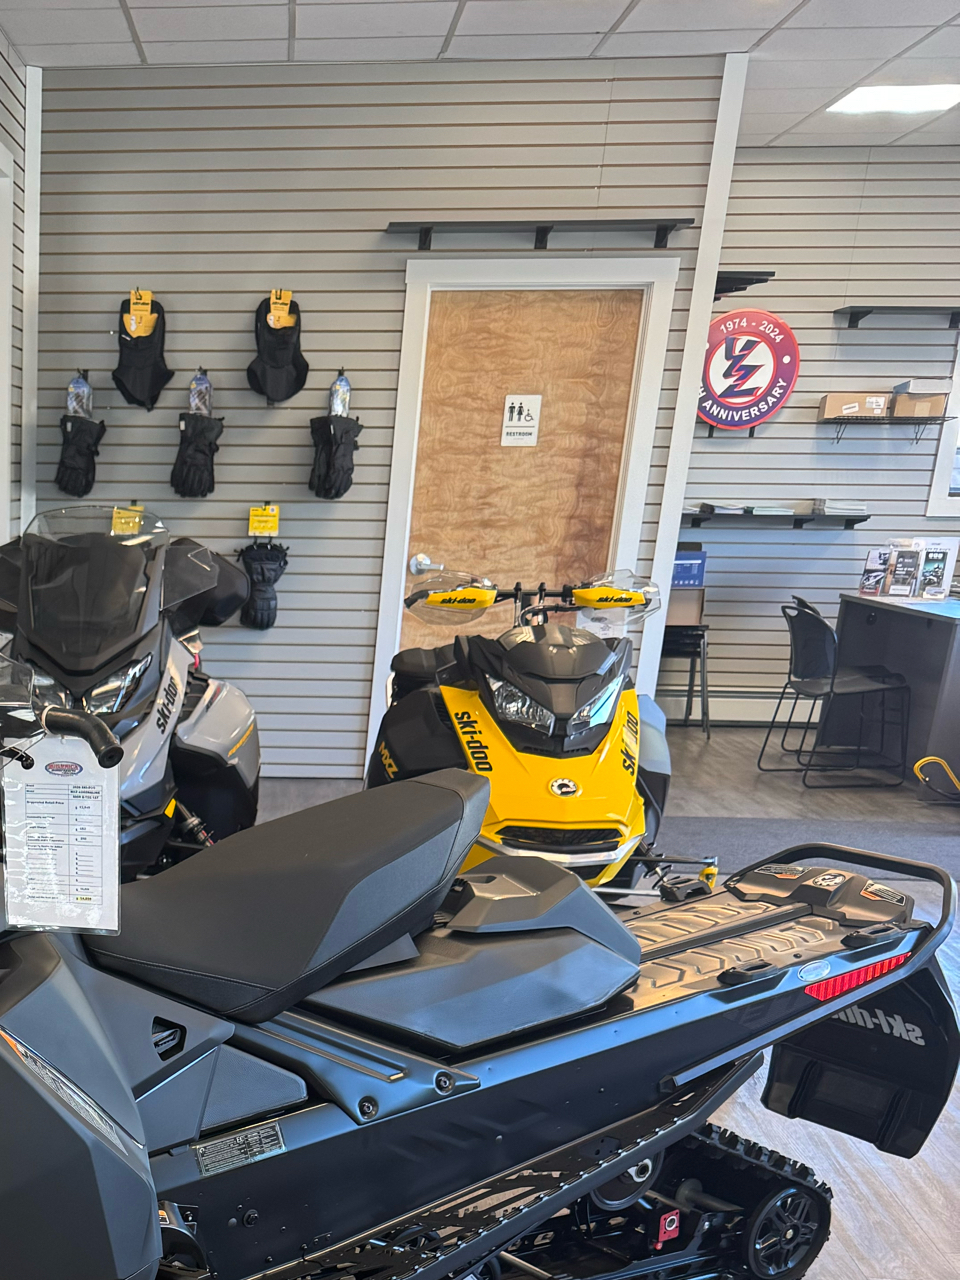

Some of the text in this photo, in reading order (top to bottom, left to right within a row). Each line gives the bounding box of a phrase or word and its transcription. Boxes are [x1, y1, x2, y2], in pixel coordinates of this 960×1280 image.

[720, 317, 748, 334] 1974
[758, 320, 785, 343] 2024
[702, 377, 788, 422] ANNIVERSARY
[440, 596, 477, 604] ski-doo
[595, 595, 633, 603] ski-doo
[454, 711, 493, 772] ski-doo
[378, 740, 399, 779] MXZ
